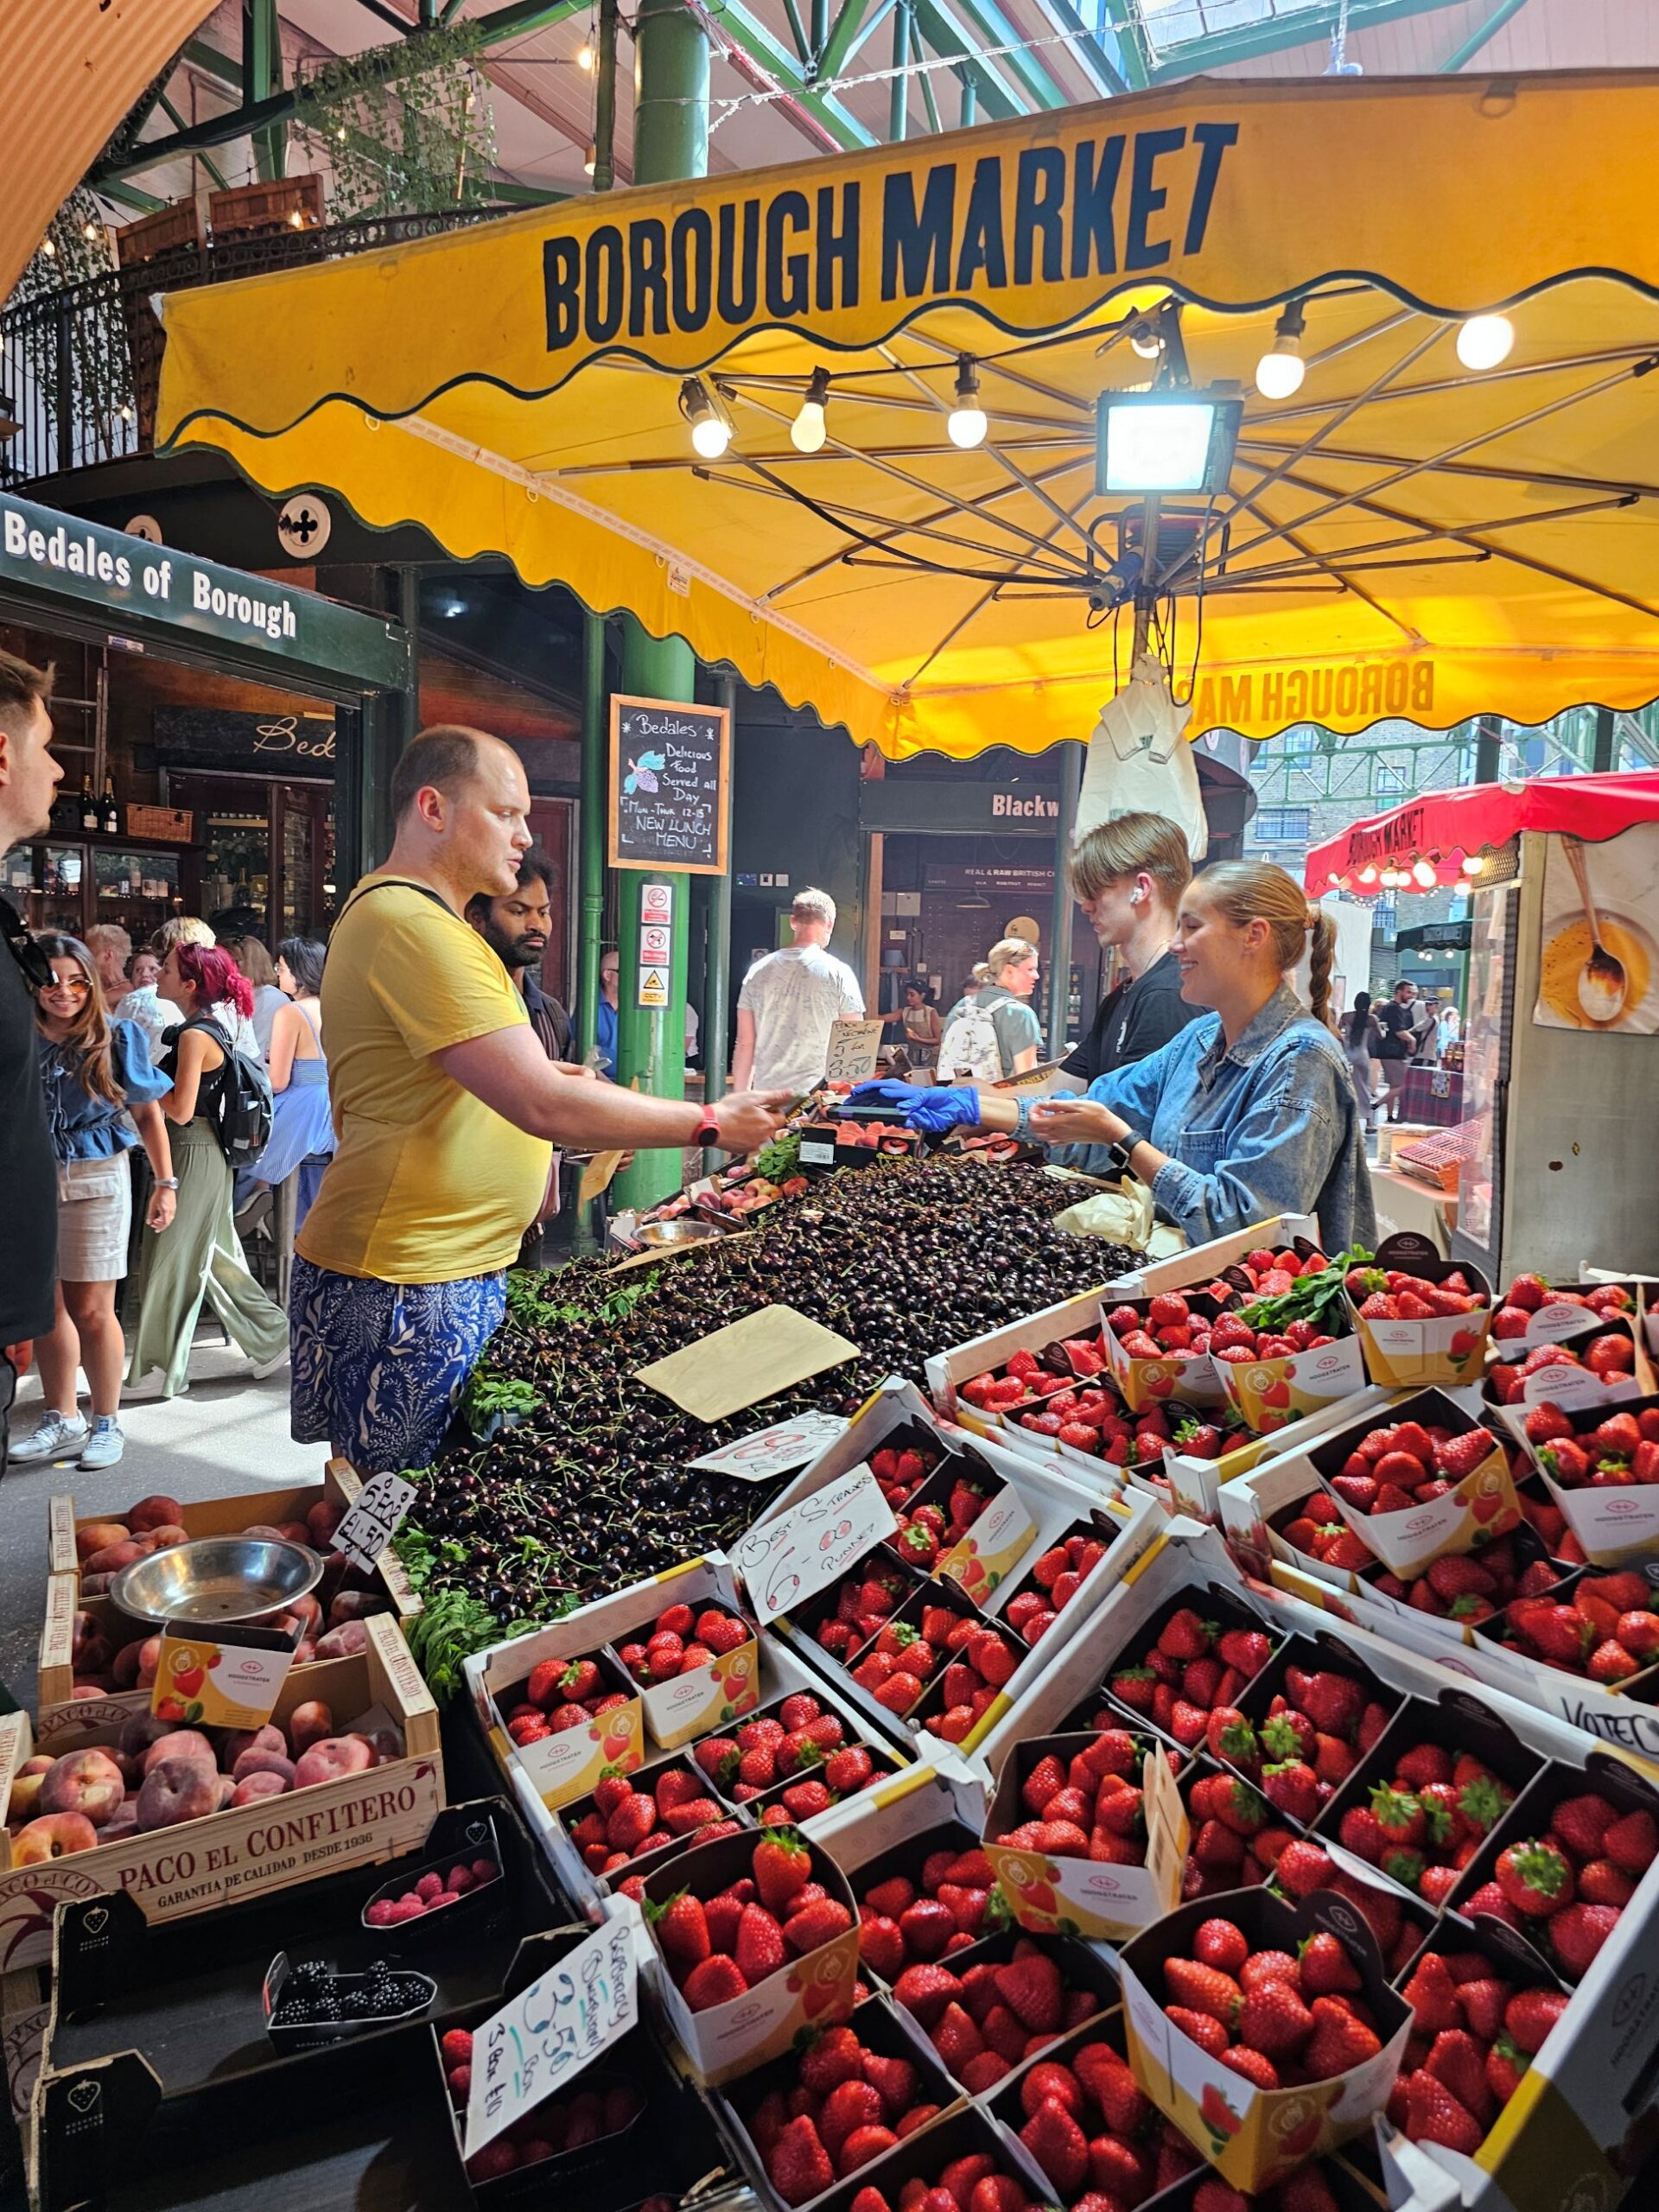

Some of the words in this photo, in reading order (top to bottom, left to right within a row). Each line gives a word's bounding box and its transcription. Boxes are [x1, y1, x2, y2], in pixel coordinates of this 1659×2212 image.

[543, 181, 861, 353] BOROUGH
[880, 122, 1241, 302] MARKET
[4, 510, 130, 588] Bedales
[143, 561, 171, 599] of
[193, 570, 297, 639] Borough
[636, 715, 697, 737] Bedales
[670, 760, 696, 773] Food
[662, 773, 698, 787] Served
[636, 816, 665, 831] NEW
[669, 819, 712, 836] LUNCH
[1384, 808, 1425, 855] MARKET
[655, 832, 696, 849] MENU
[359, 1484, 381, 1510] 5
[43, 1706, 93, 1732] PACO
[118, 1851, 196, 1892] PACO
[207, 1844, 238, 1872] EL
[246, 1785, 416, 1858] CONFITERO
[157, 1880, 222, 1908] GARANTIA
[224, 1873, 242, 1887] DE
[243, 1856, 296, 1882] CALIDAD
[303, 1841, 342, 1864] DESDE
[344, 1832, 373, 1851] 1936
[488, 2022, 505, 2048] 3
